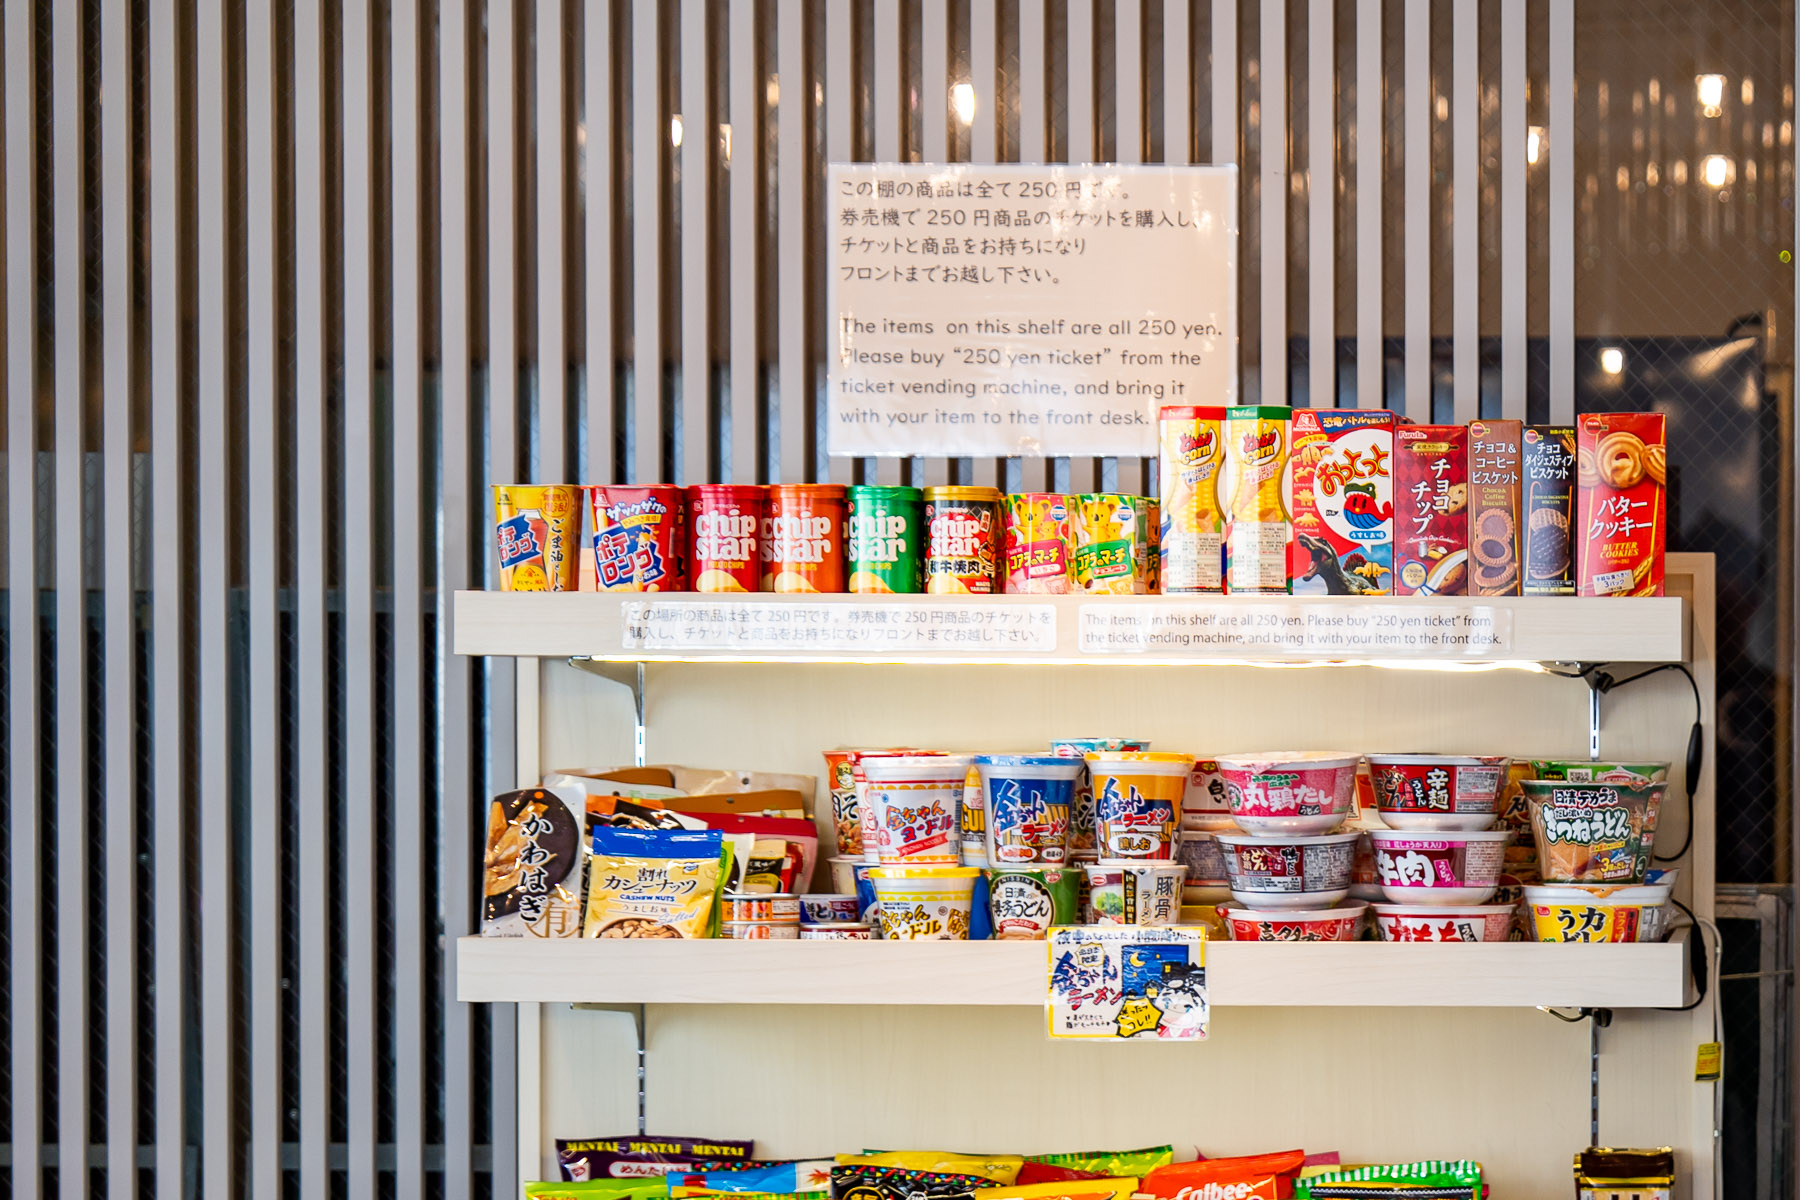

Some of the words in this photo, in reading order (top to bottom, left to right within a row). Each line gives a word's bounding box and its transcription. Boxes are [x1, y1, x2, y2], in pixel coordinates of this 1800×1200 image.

[841, 180, 1010, 199] この棚の商品は全て
[841, 209, 920, 227] 券売機で
[928, 209, 965, 226] 250
[841, 237, 1086, 256] チケットと商品をお持ちになり
[841, 265, 1059, 284] フロントまでお越し下さい。
[841, 318, 875, 334] The
[883, 319, 934, 334] items
[946, 323, 968, 334] on
[975, 319, 1010, 334] this
[1017, 319, 1065, 334] shelf
[1071, 323, 1101, 334] are
[1109, 319, 1131, 334] all
[1138, 320, 1176, 335] 250
[1182, 323, 1222, 339] yen.
[911, 348, 944, 368] buy
[1008, 353, 1040, 368] yen
[1121, 348, 1163, 364] from
[1170, 349, 1200, 364] the
[841, 379, 895, 394] ticket
[902, 379, 976, 398] vending
[983, 379, 1067, 397] machine,
[1074, 379, 1109, 394] and
[1116, 379, 1164, 398] bring
[1172, 380, 1185, 394] it
[841, 409, 879, 424] with
[887, 413, 929, 427] your
[935, 410, 975, 424] item
[984, 411, 1001, 424] to
[1009, 409, 1039, 424] the
[1046, 409, 1092, 424] front
[1100, 409, 1150, 425] desk.
[1316, 443, 1389, 497] おっとっと
[1472, 471, 1518, 485] ビスケット
[1431, 458, 1451, 511] チョコ
[1411, 481, 1433, 534] チップ
[1598, 495, 1648, 517] バター
[695, 509, 757, 540] chip
[1590, 517, 1653, 541] クッキー
[596, 534, 630, 561] ポテ
[695, 533, 757, 562] star
[1600, 549, 1639, 558] COOKIES
[1602, 542, 1637, 551] BUTTER
[602, 552, 653, 582] ロング
[1426, 768, 1450, 810] 辛麺
[517, 813, 553, 923] かわはぎ
[604, 876, 697, 893] カシューナッツ
[692, 1144, 743, 1156] MENTAI
